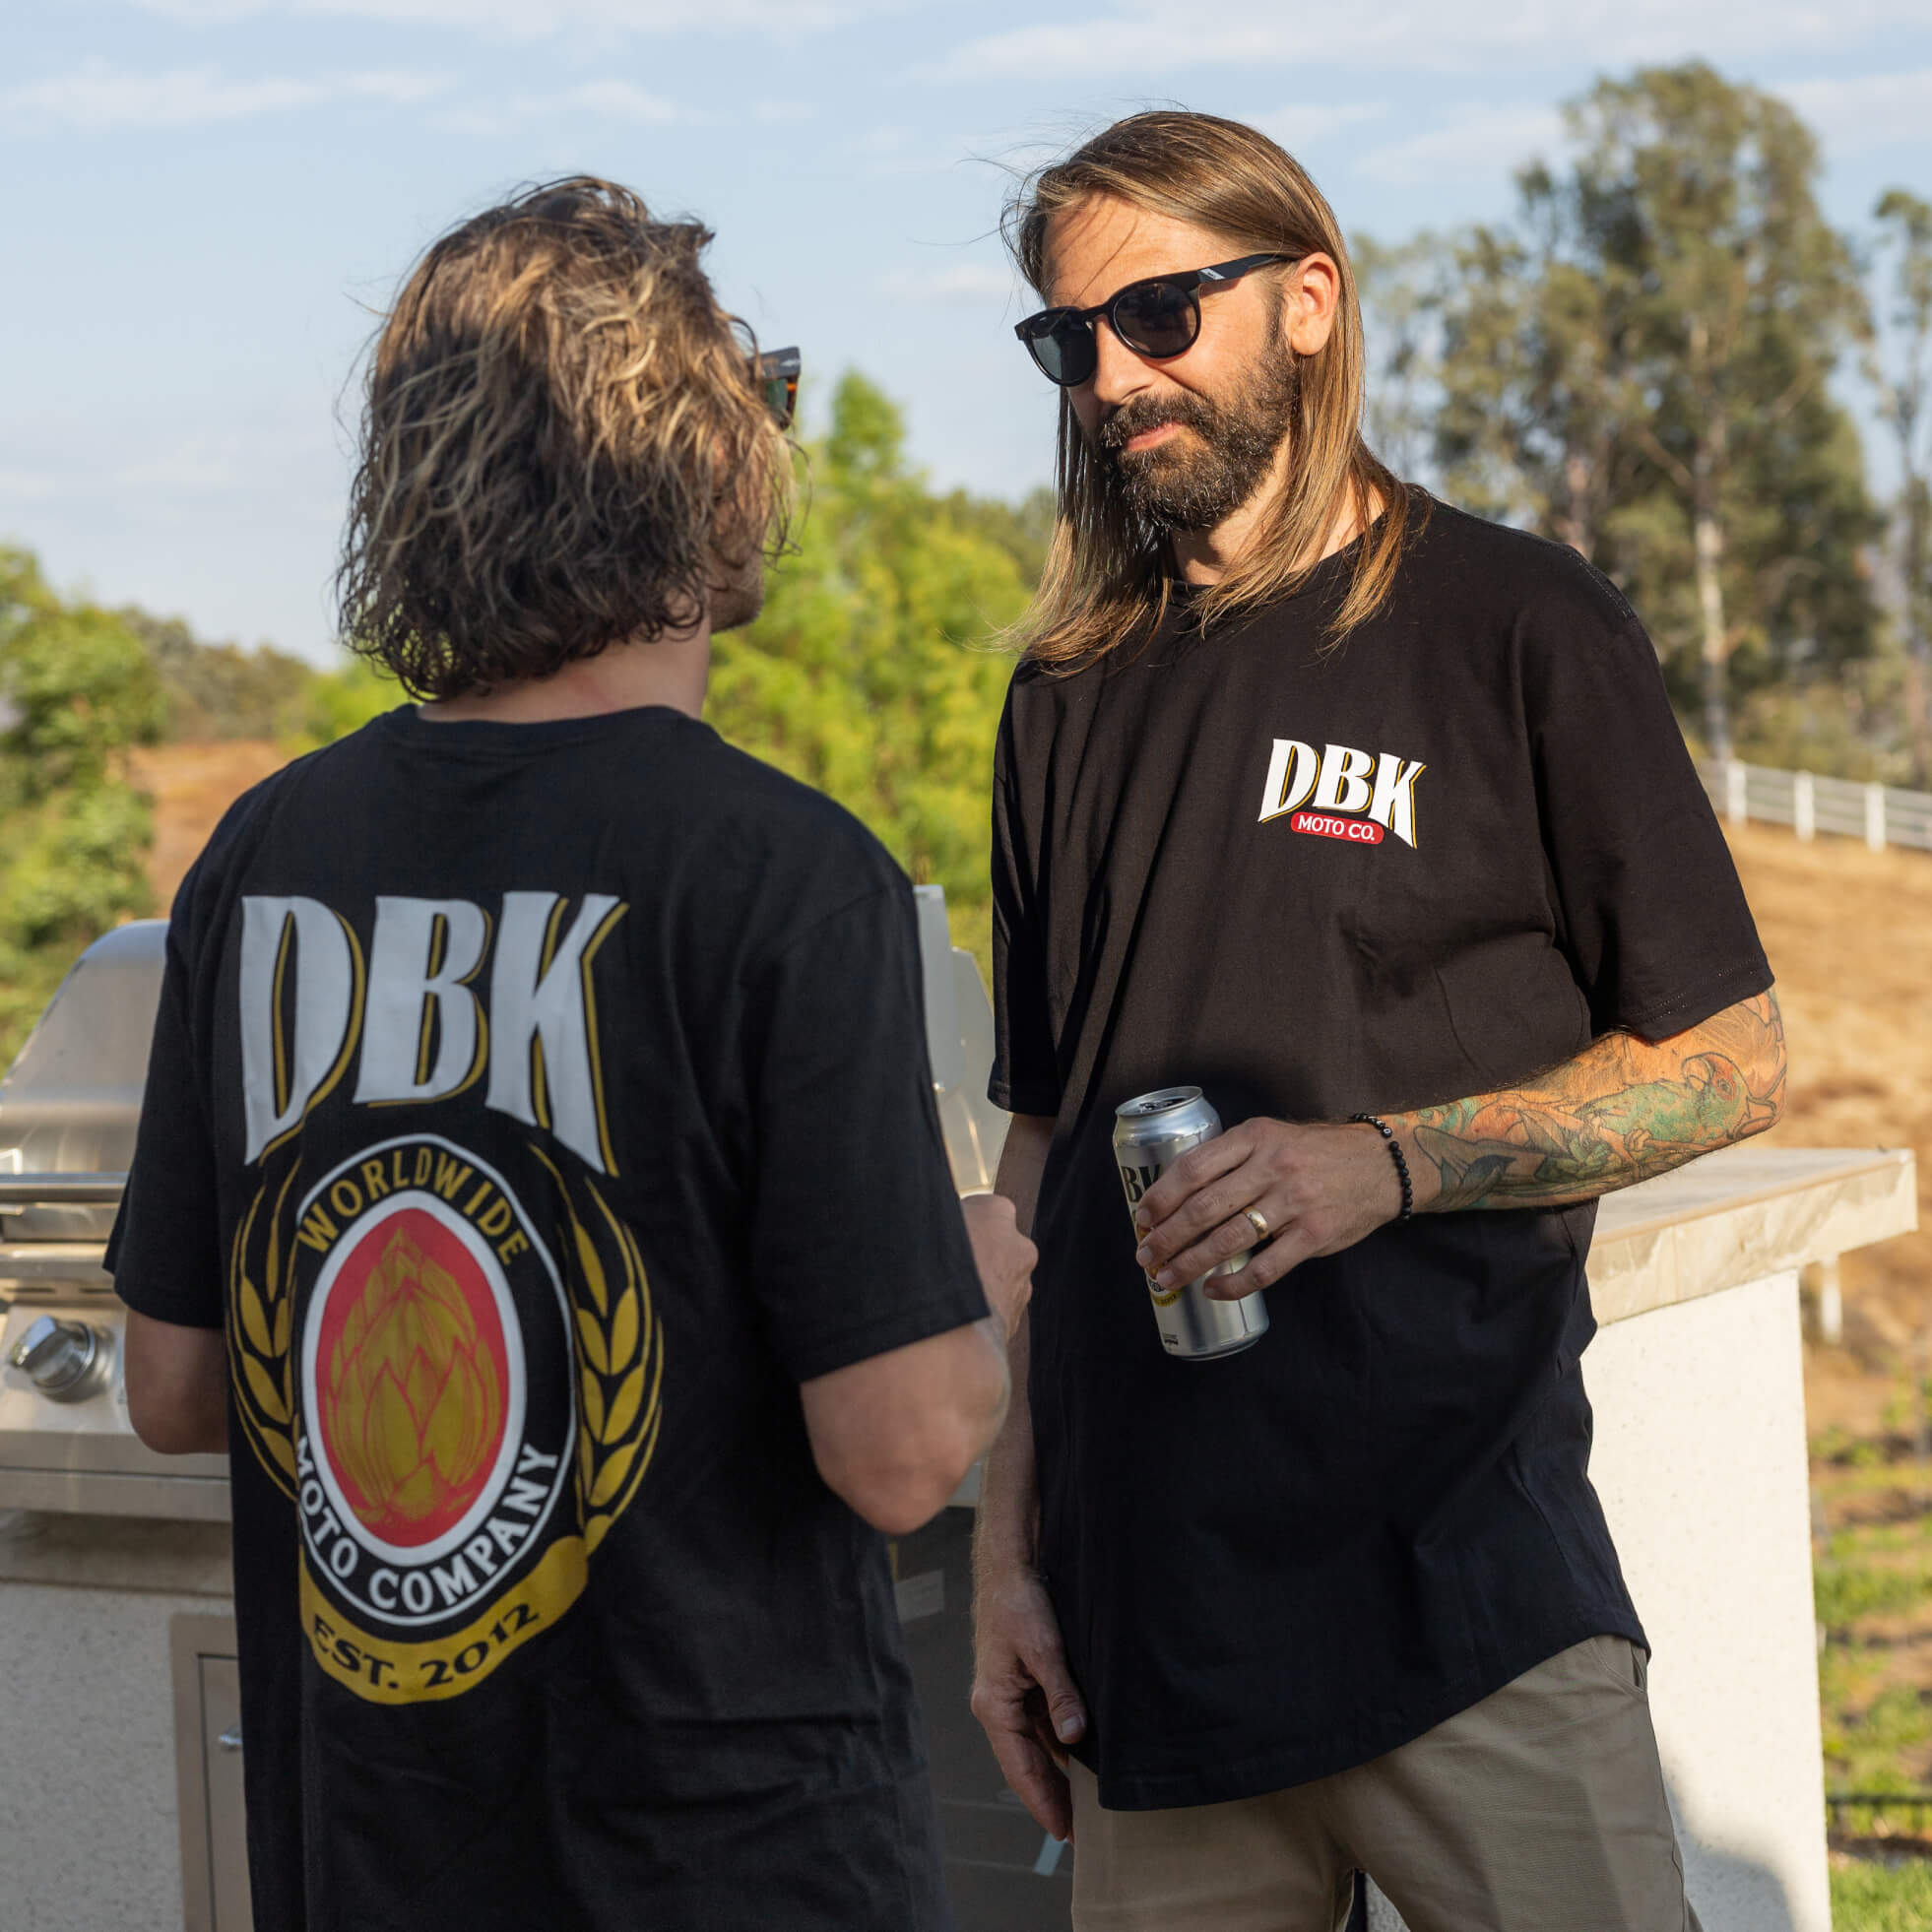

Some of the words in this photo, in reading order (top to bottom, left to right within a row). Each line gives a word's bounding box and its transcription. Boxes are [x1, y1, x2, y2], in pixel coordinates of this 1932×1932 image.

[1257, 739, 1426, 849] DBK
[1297, 815, 1345, 835] MOTO
[1348, 823, 1376, 841] CO.
[239, 891, 629, 1177] DBK
[297, 1147, 528, 1263] WORLDWIDE
[297, 1437, 358, 1578] MOTO
[369, 1443, 558, 1613] COMPANY
[313, 1614, 399, 1689] EST.
[419, 1603, 539, 1689] 2012
